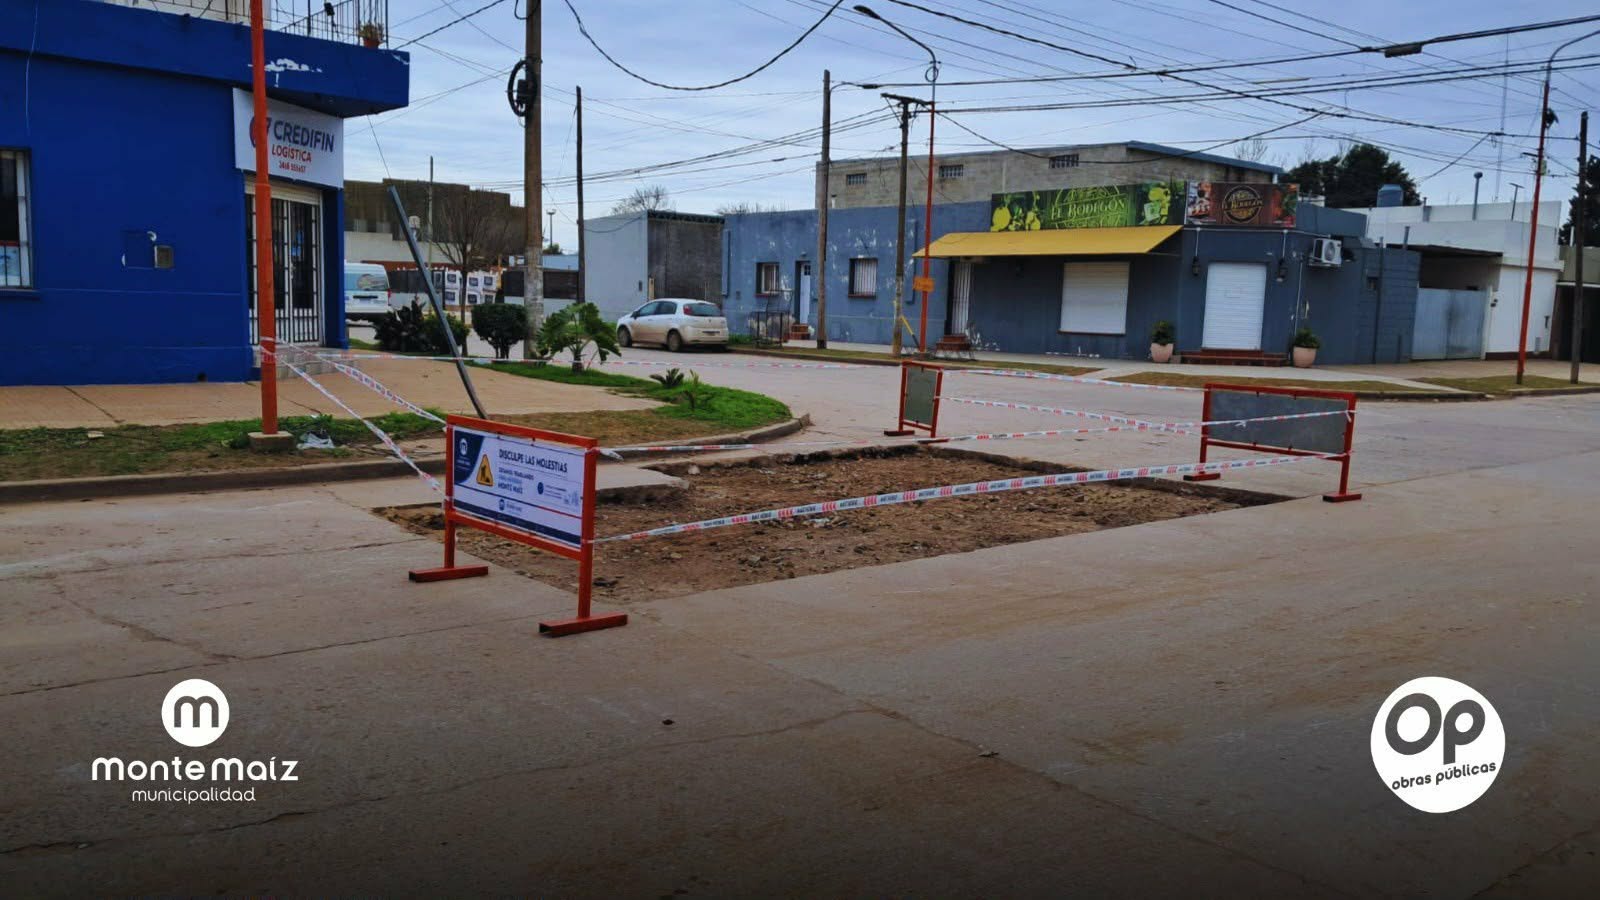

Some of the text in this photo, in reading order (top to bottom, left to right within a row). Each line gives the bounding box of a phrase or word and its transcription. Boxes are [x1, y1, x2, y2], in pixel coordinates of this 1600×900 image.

[274, 121, 334, 152] CREDIFIN
[499, 449, 568, 473] DISCULPE LAS MOLESTIAS
